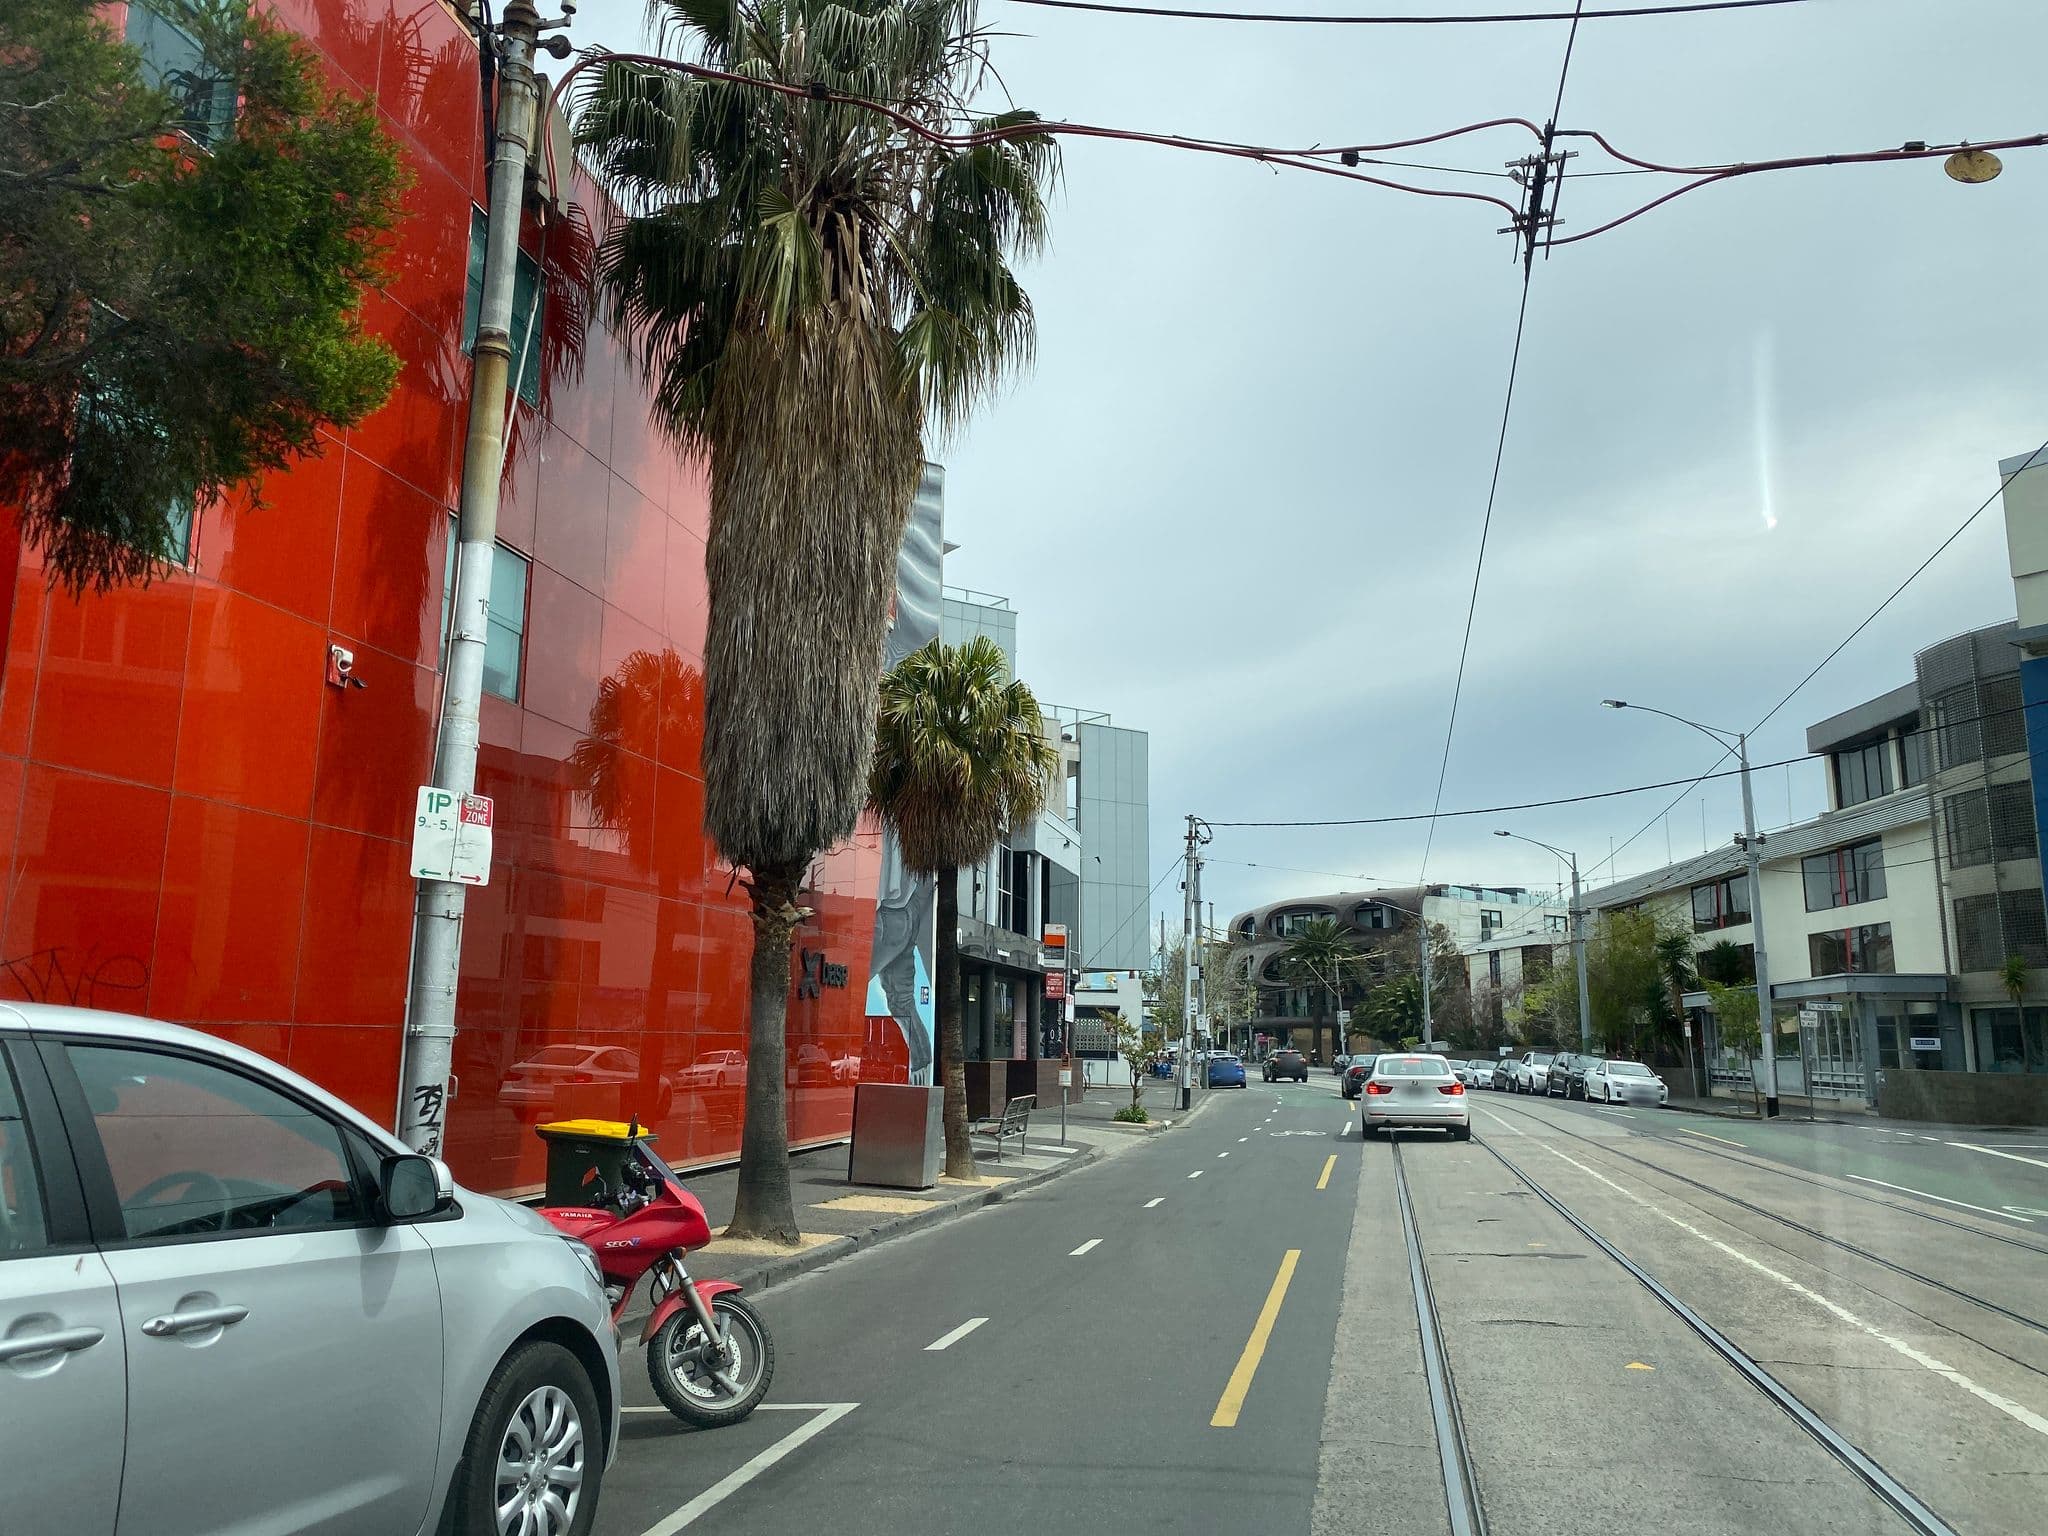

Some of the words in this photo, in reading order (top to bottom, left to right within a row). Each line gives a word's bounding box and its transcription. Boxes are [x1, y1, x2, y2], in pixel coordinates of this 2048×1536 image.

[427, 792, 452, 814] 1P
[465, 798, 489, 813] BUS
[466, 811, 488, 825] ZONE
[821, 953, 849, 987] base
